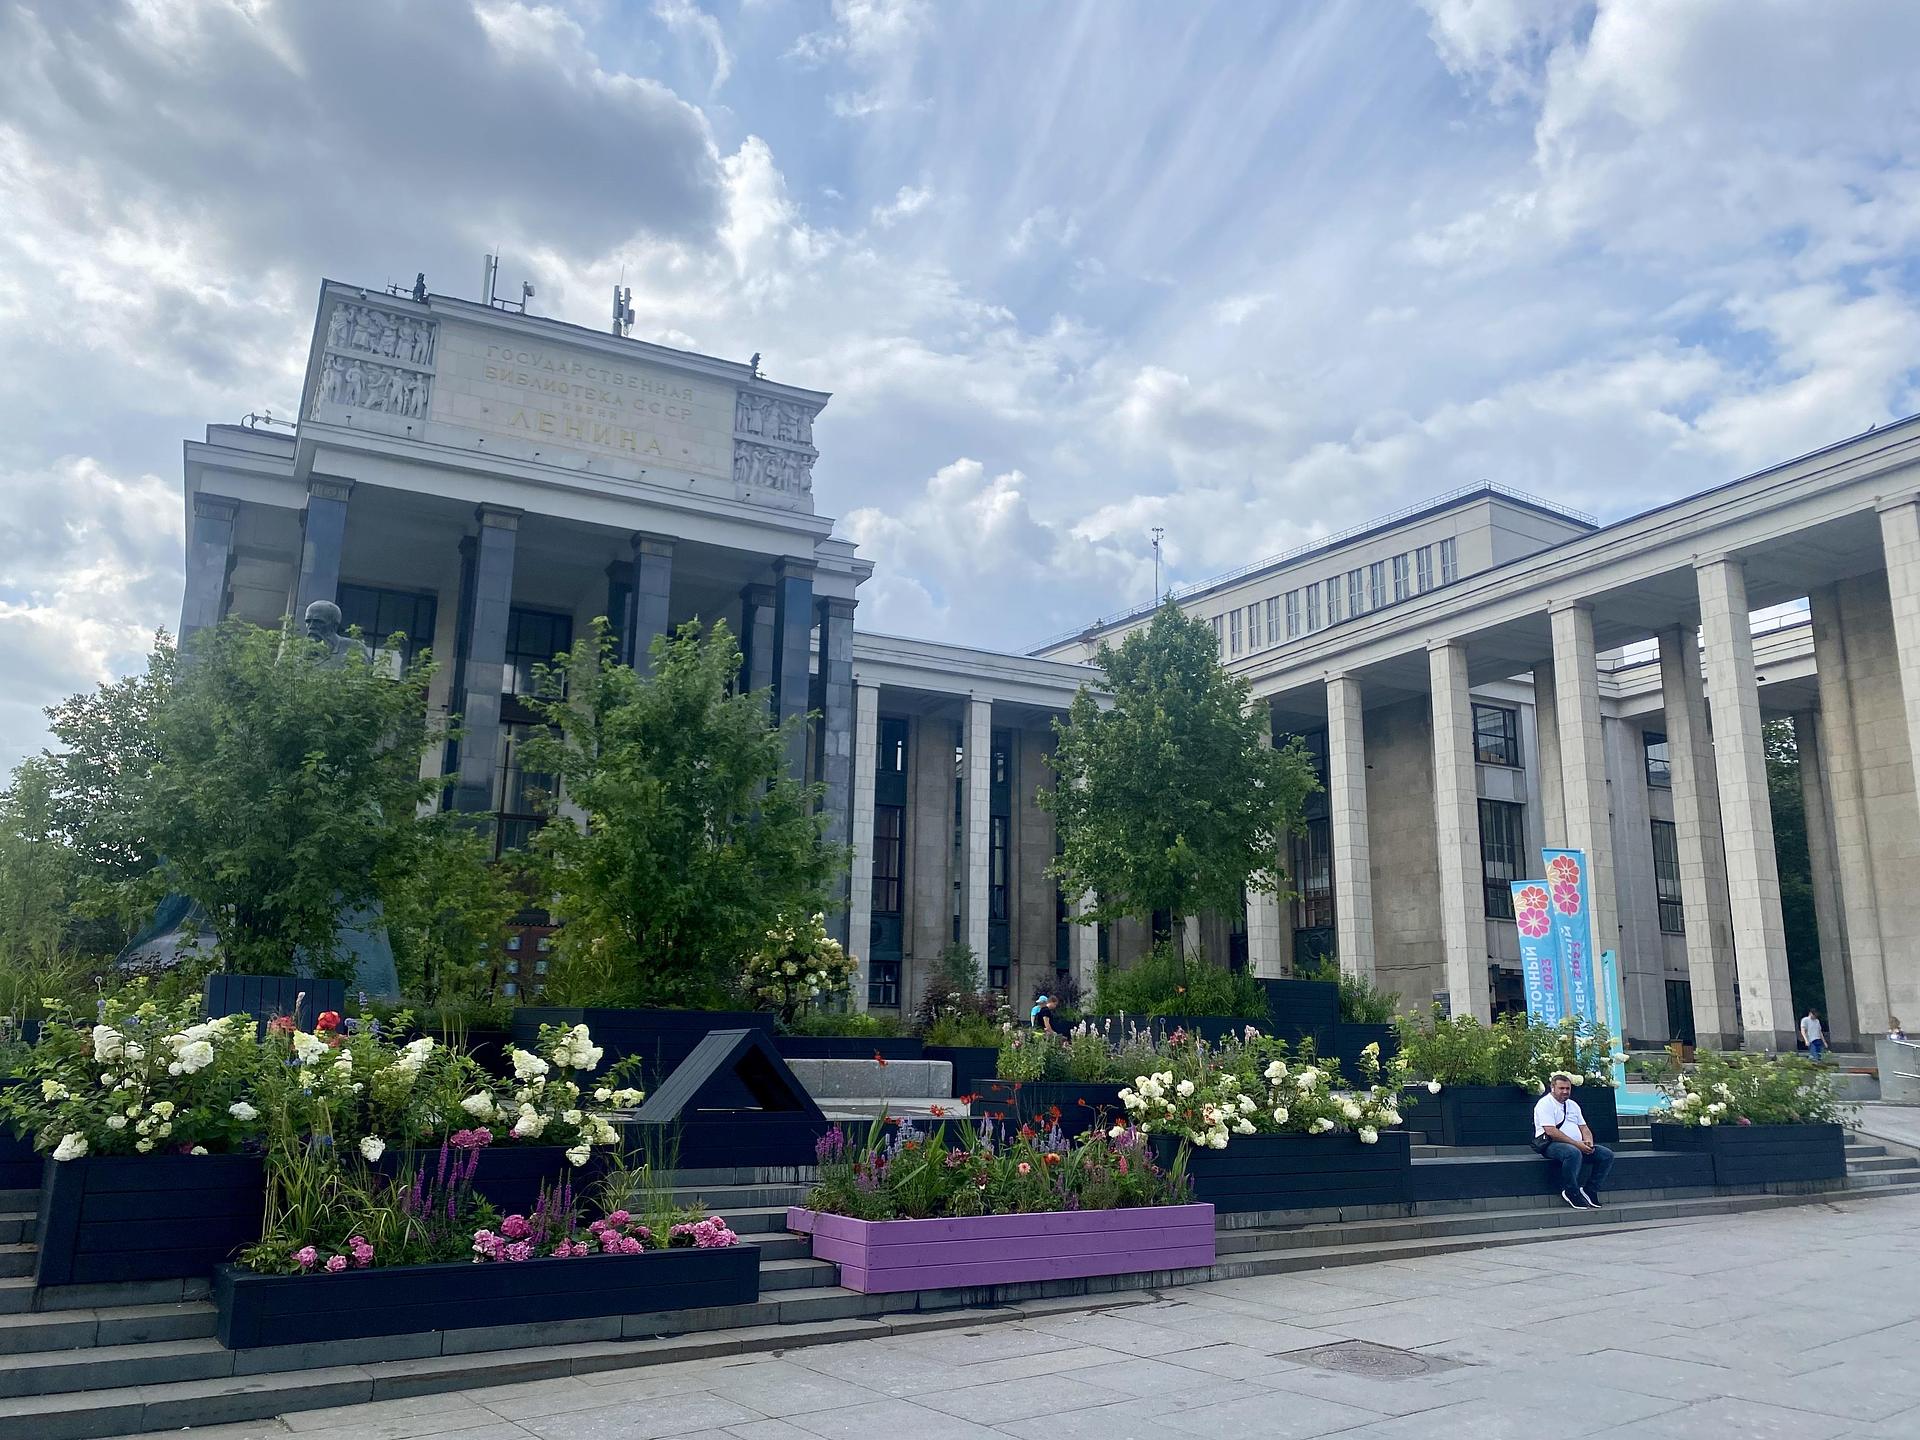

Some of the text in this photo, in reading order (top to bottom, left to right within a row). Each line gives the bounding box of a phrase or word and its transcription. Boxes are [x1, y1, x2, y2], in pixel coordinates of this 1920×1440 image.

[484, 366, 693, 420] БИБЛИОТЕКА СССР
[486, 345, 693, 401] ГОСУДАРСТВЕННАЯ
[510, 408, 663, 456] ЛЕНИНА
[1541, 958, 1554, 990] 2023
